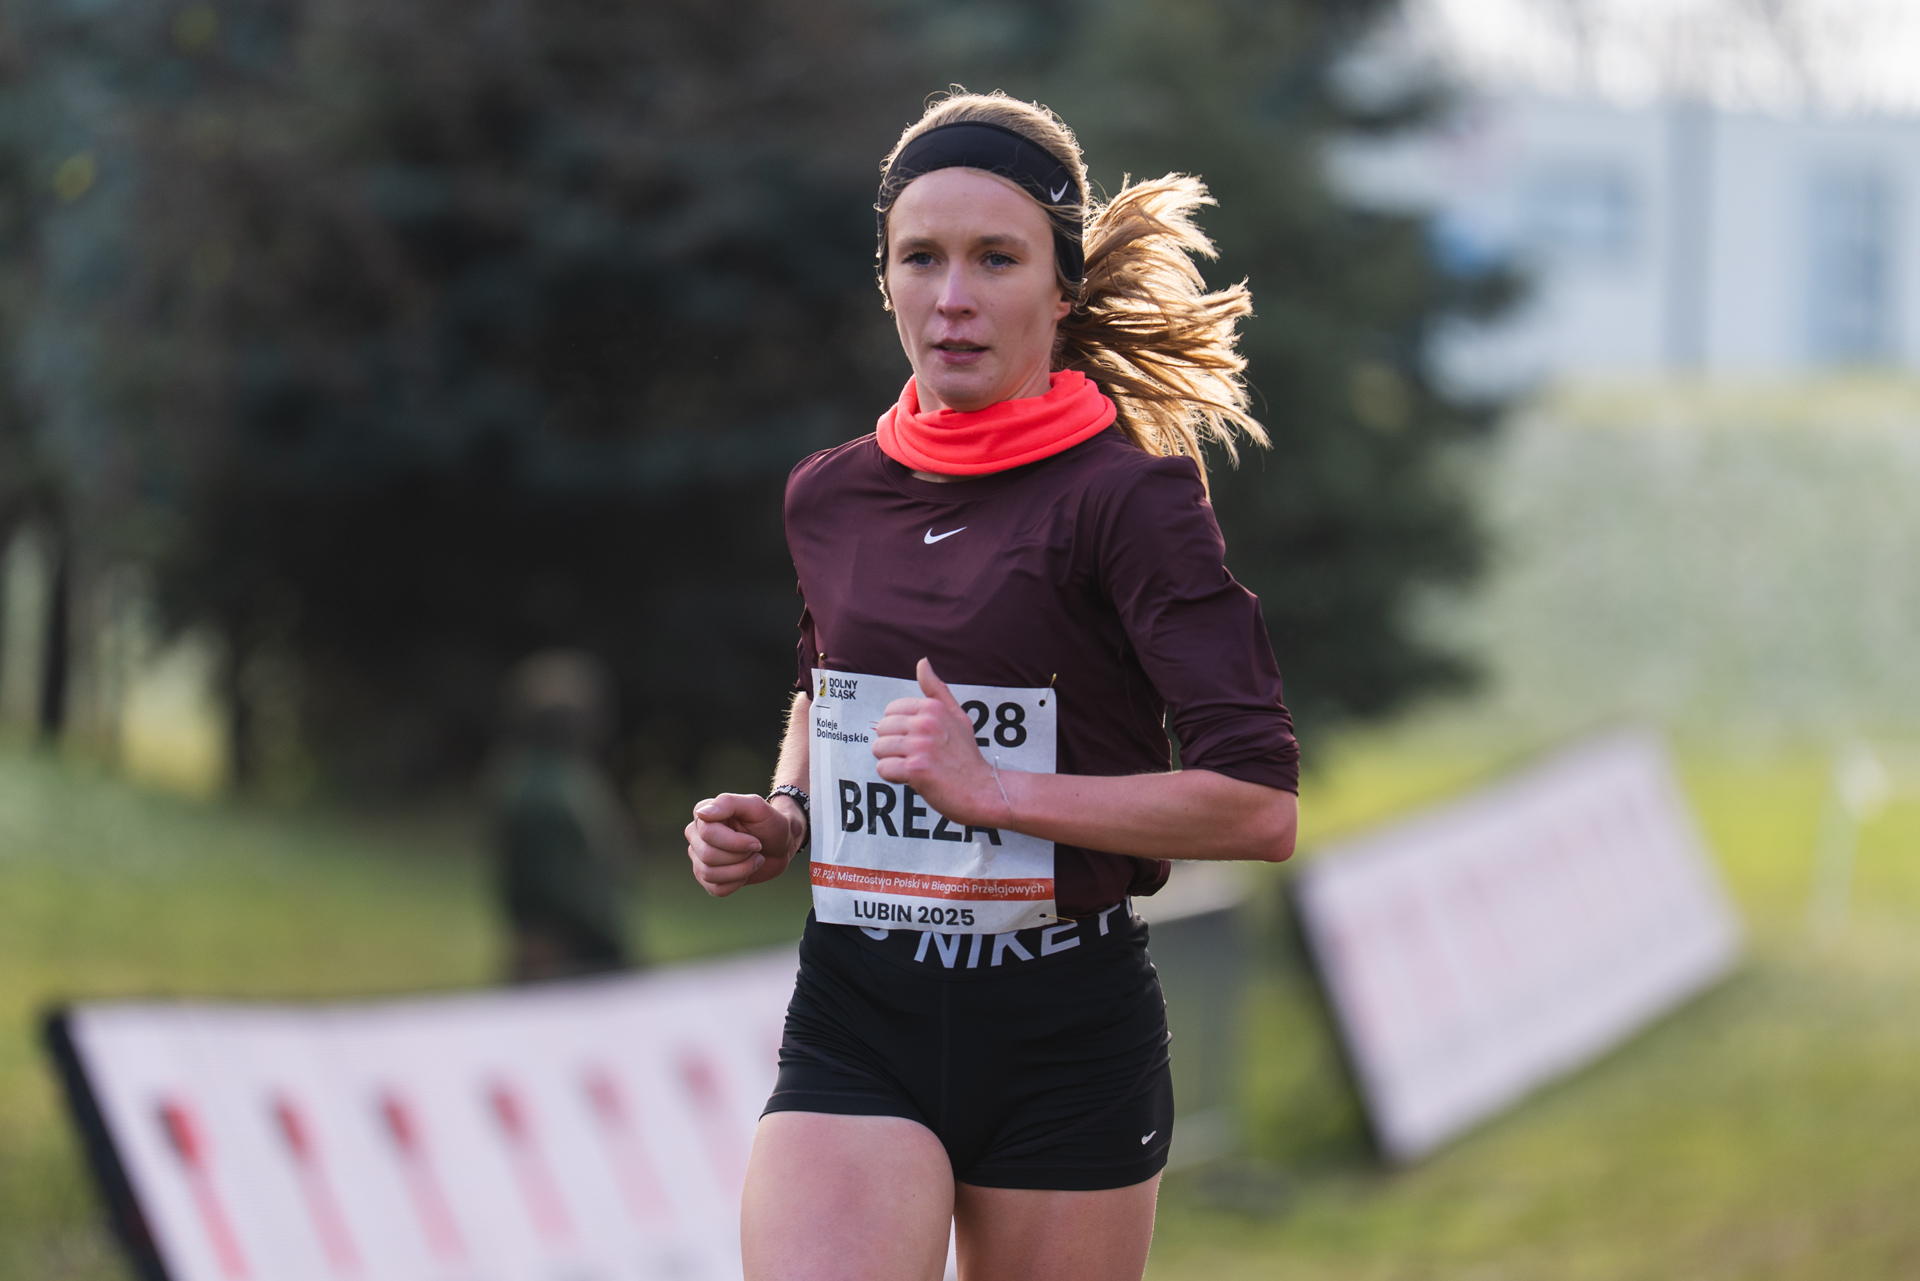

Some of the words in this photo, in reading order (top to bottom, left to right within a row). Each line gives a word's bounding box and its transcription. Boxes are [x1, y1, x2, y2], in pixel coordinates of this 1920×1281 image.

[829, 677, 858, 690] DOLNY
[829, 686, 857, 701] ŚLĄSK
[816, 717, 838, 731] Koleje
[960, 700, 1027, 748] 28
[816, 727, 869, 744] Dolnośląskie
[837, 871, 892, 886] Mistrzostwa
[894, 877, 920, 889] Polski
[921, 881, 930, 889] w
[931, 880, 970, 894] Biegach
[854, 899, 912, 923] LUBIN
[917, 906, 975, 926] 2025
[913, 921, 1080, 969] NIKE
